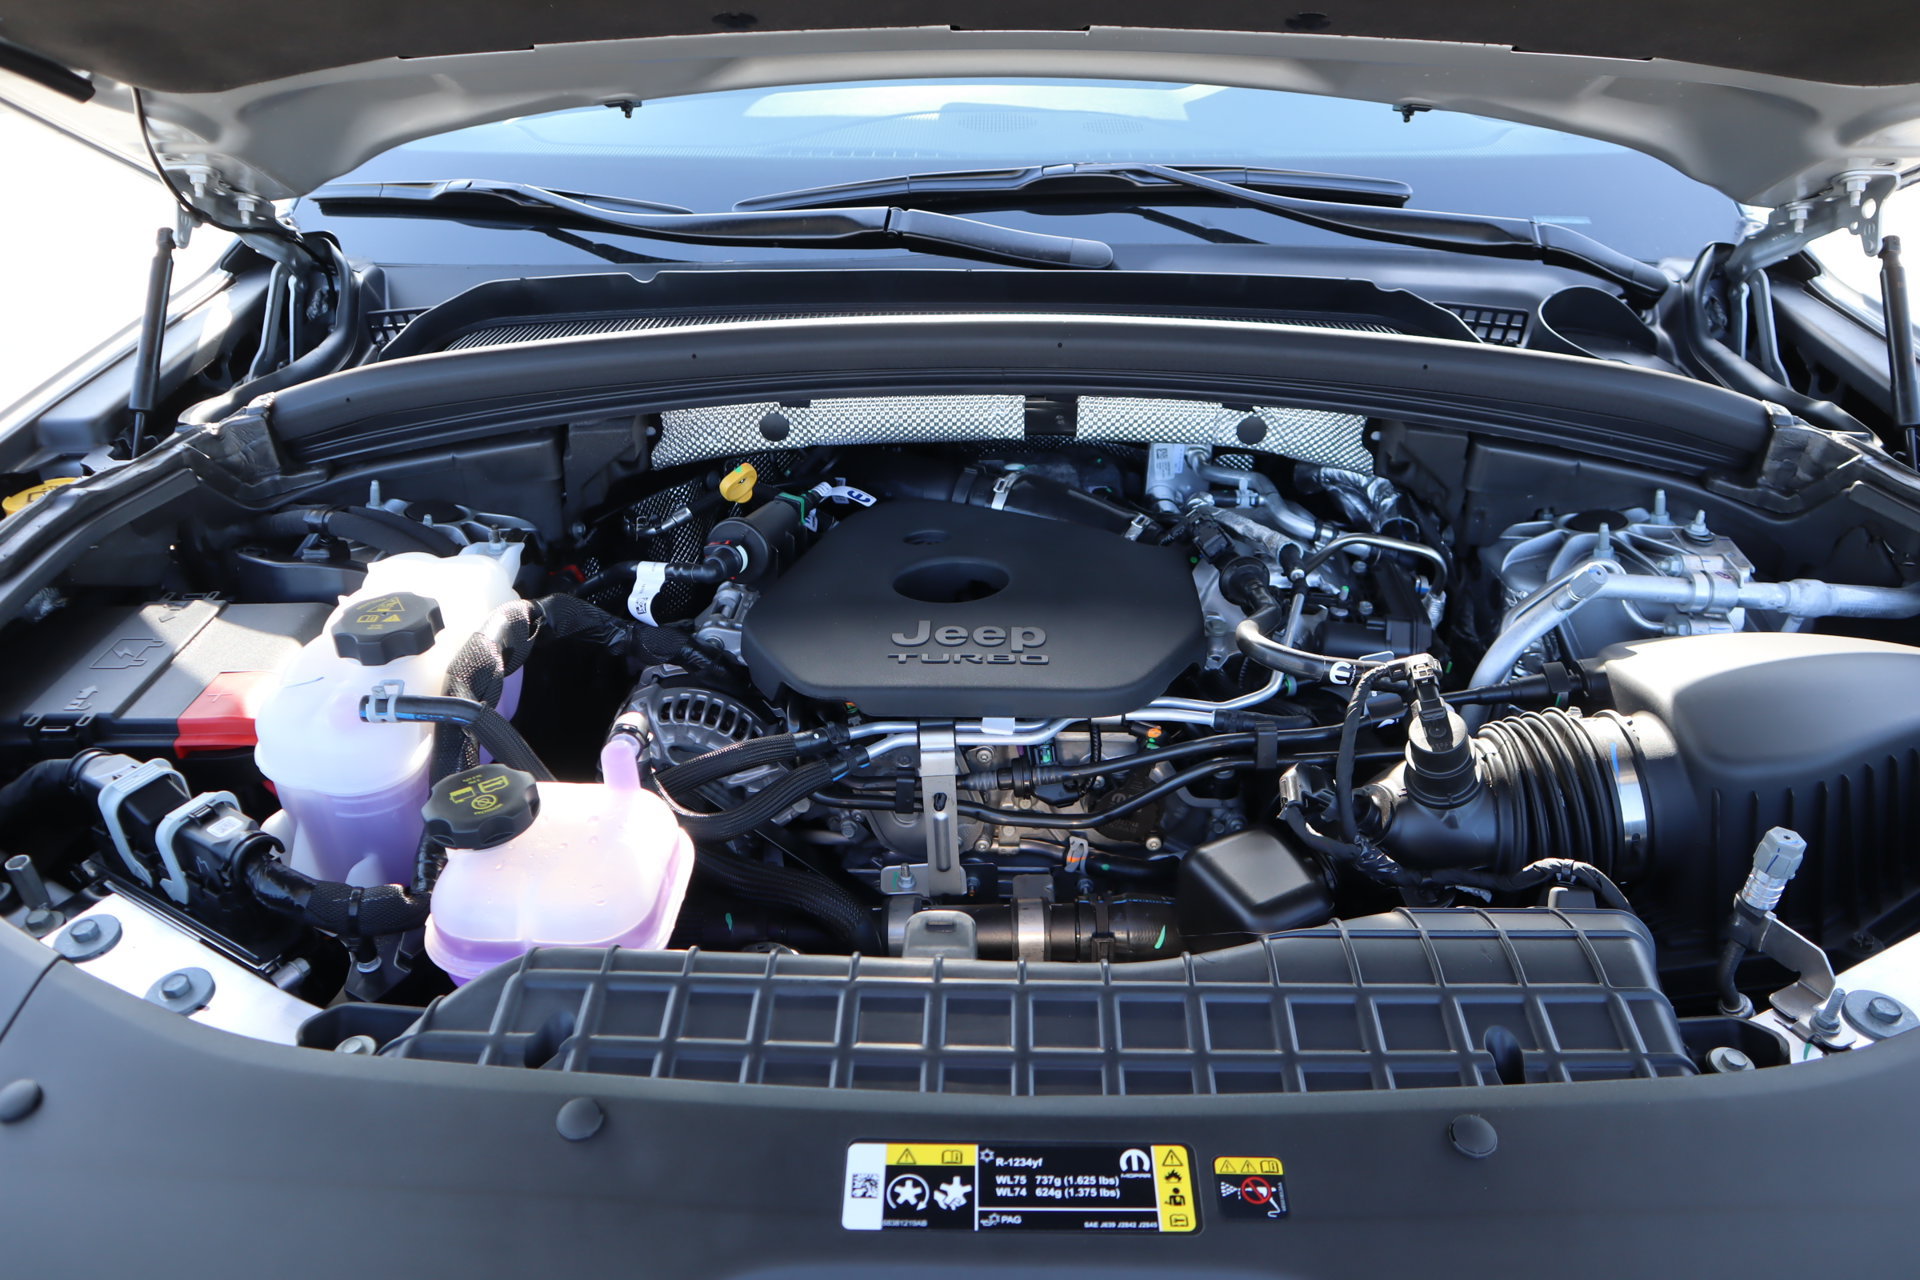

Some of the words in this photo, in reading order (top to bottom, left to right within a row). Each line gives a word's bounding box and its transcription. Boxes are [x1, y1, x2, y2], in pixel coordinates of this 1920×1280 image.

[891, 620, 1047, 653] Jeep
[887, 653, 1049, 665] TURBO
[995, 1157, 1043, 1169] R-1234yf
[995, 1175, 1027, 1185] WL75
[1035, 1175, 1061, 1187] 737g
[1063, 1175, 1096, 1187] (1.625
[1099, 1175, 1120, 1187] lbs)
[995, 1187, 1027, 1197] WL74
[1035, 1187, 1062, 1199] 624g
[1064, 1187, 1097, 1199] (1.375
[1099, 1187, 1121, 1199] lbs)
[1001, 1215, 1022, 1225] PAG
